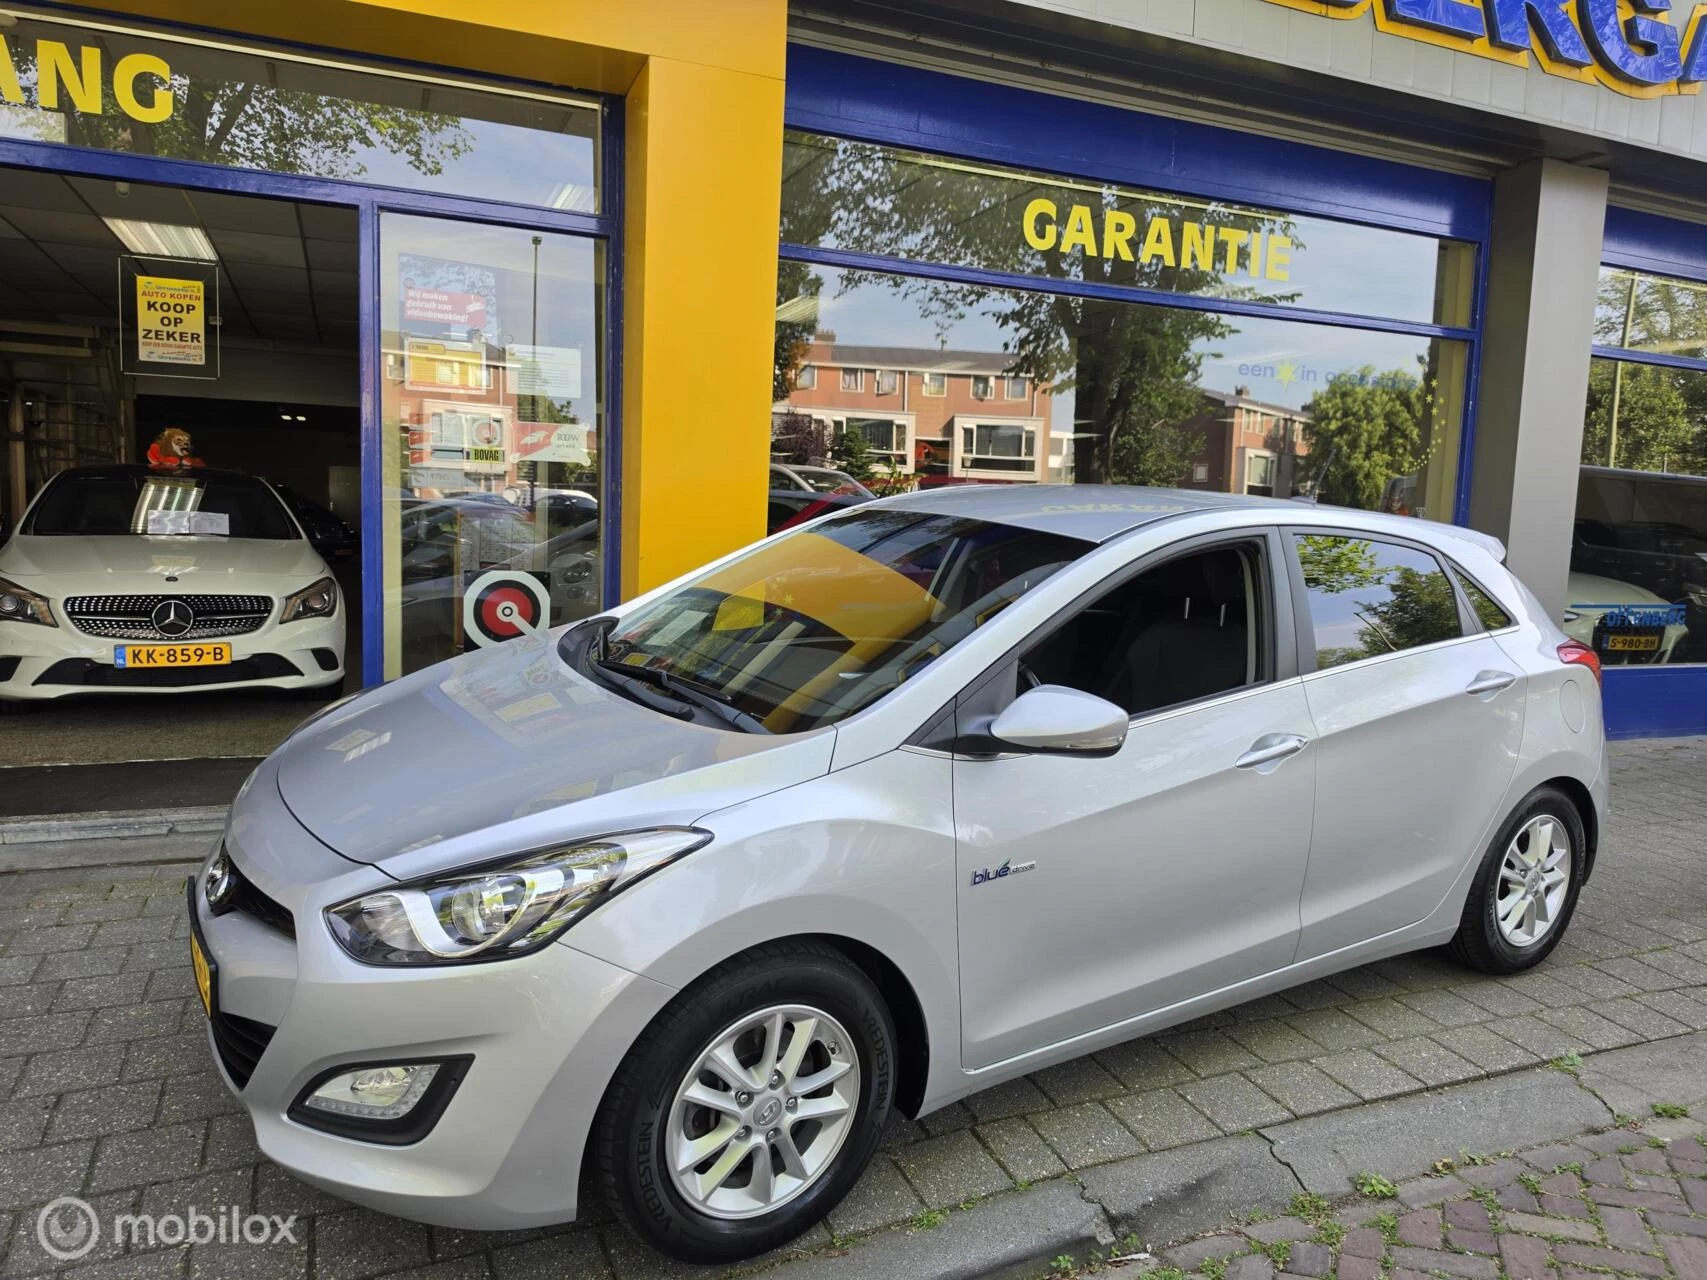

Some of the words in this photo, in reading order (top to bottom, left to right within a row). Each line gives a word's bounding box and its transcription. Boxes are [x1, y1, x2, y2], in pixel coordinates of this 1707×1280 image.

[1023, 198, 1292, 281] GARANTIE
[141, 290, 167, 299] AUTO
[169, 293, 201, 302] KOPEN
[147, 301, 196, 314] KOOP
[160, 316, 183, 327] OP
[142, 329, 201, 343] ZEKER
[1238, 363, 1275, 378] een
[1301, 365, 1317, 382] in
[474, 449, 499, 461] BOVAG
[132, 646, 225, 664] KK-859-B
[971, 861, 1010, 886] blue
[1012, 863, 1036, 873] drive
[863, 1007, 889, 1112] VREDESTEIN
[637, 1121, 673, 1232] VREDESTEIN
